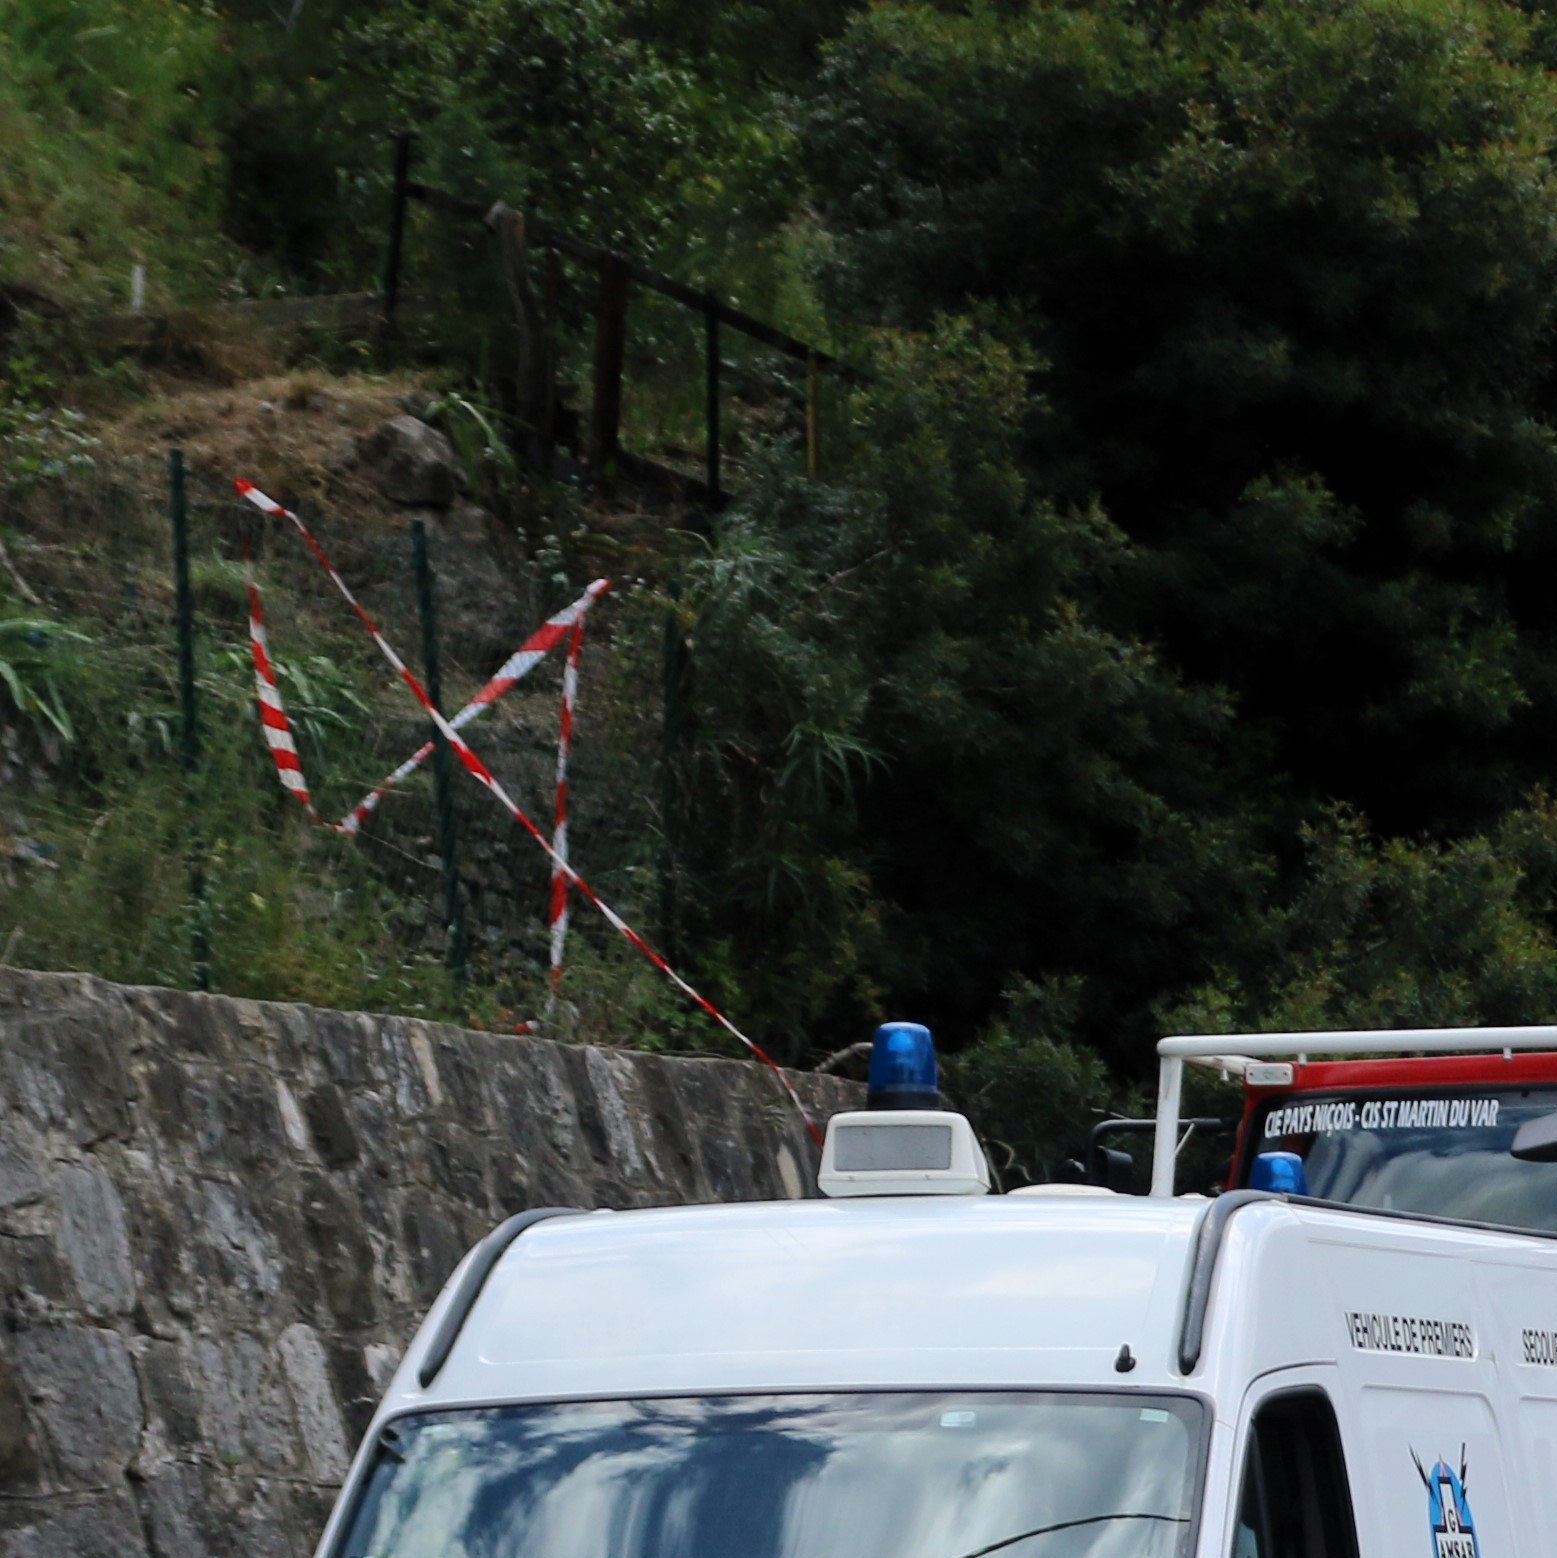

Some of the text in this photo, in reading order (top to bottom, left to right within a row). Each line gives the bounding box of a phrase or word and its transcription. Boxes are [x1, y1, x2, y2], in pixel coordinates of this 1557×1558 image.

[1265, 1109, 1283, 1138] CIE
[1282, 1106, 1313, 1136] PAYS
[1313, 1102, 1355, 1137] NIÇOIS
[1361, 1101, 1380, 1129] CIS
[1382, 1101, 1398, 1128] ST
[1399, 1100, 1449, 1128] MARTIN
[1449, 1100, 1470, 1127] DU
[1470, 1100, 1499, 1127] VAR
[1344, 1312, 1402, 1352] VEHICULE
[1401, 1316, 1420, 1353] DE
[1419, 1318, 1473, 1359] PREMIERS
